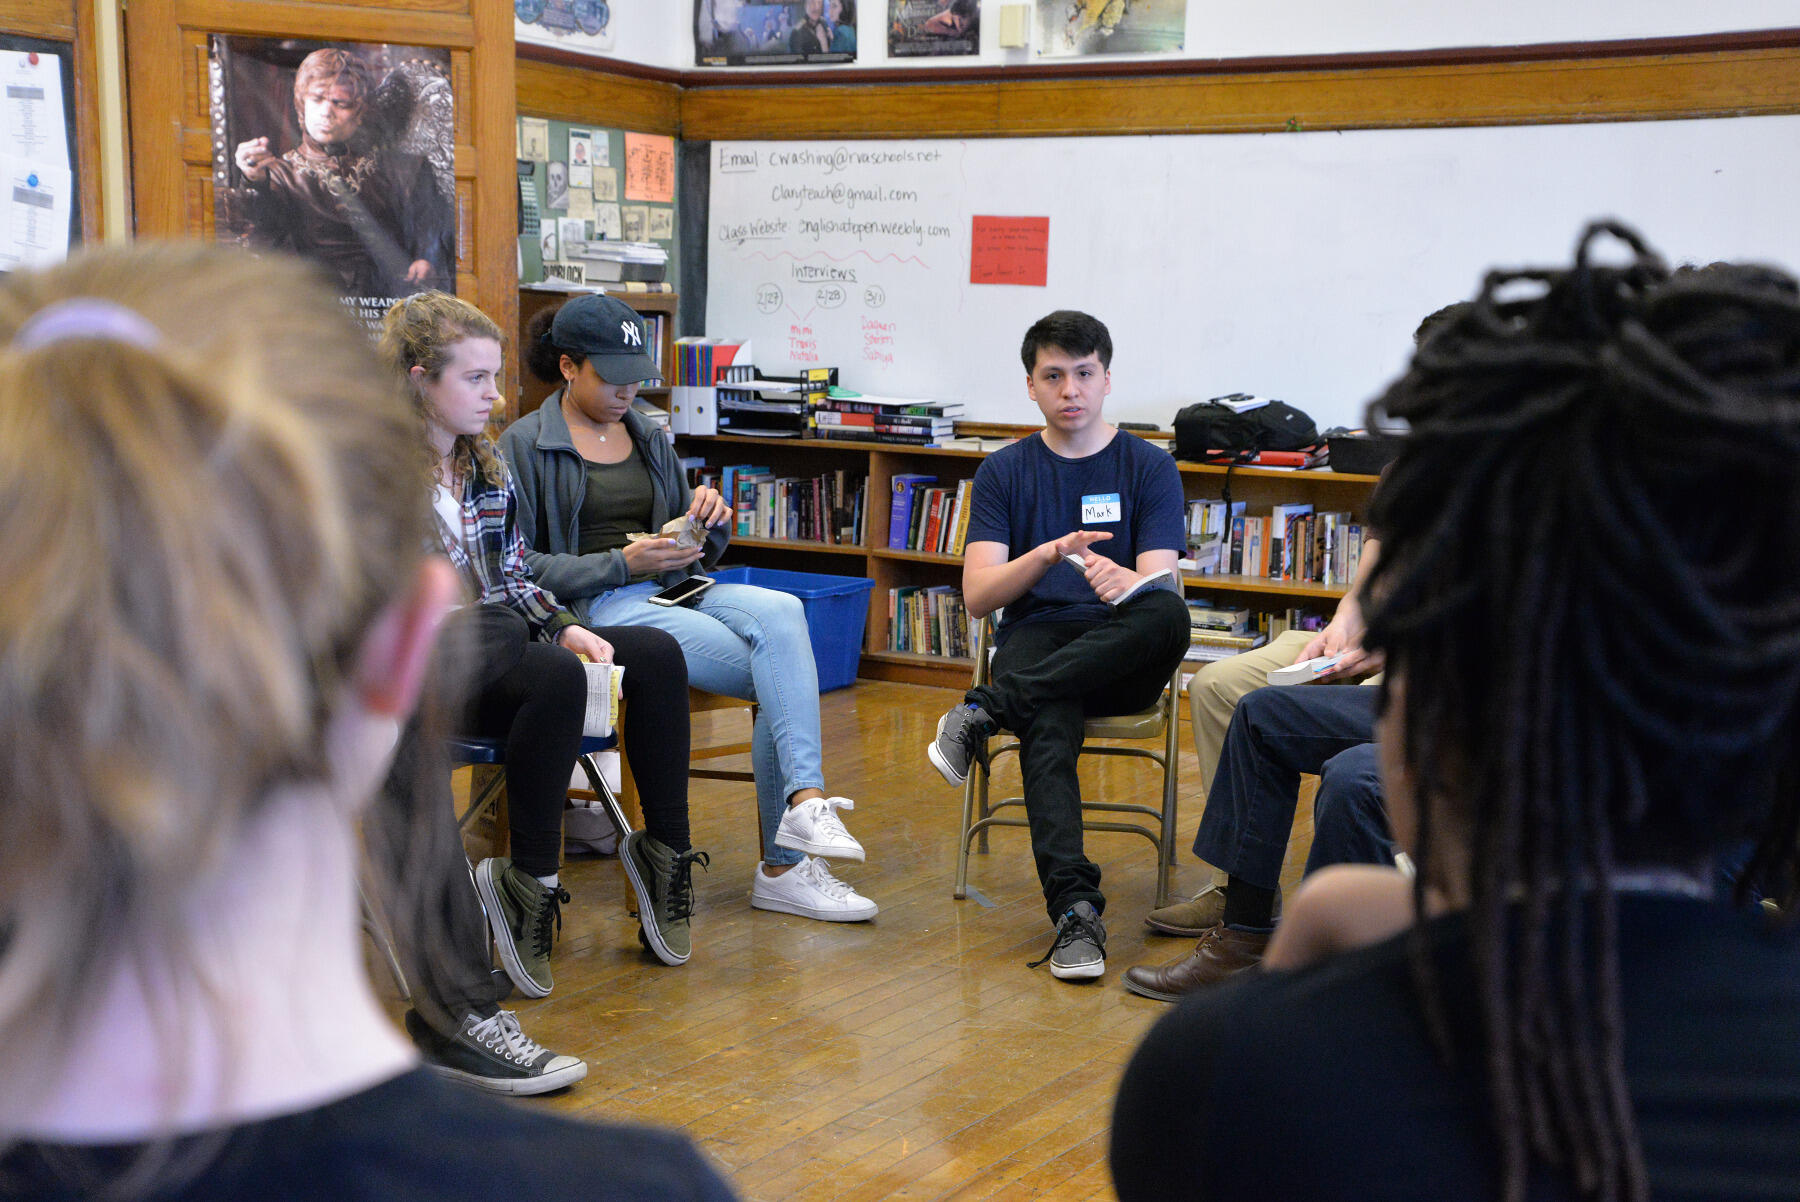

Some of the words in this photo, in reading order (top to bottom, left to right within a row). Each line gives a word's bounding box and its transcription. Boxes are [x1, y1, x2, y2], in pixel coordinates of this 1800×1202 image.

[720, 147, 759, 169] Email
[791, 263, 857, 280] Interviews
[340, 296, 356, 305] MY
[360, 309, 379, 318] HIS
[621, 320, 642, 346] NY
[1085, 504, 1112, 520] Mark
